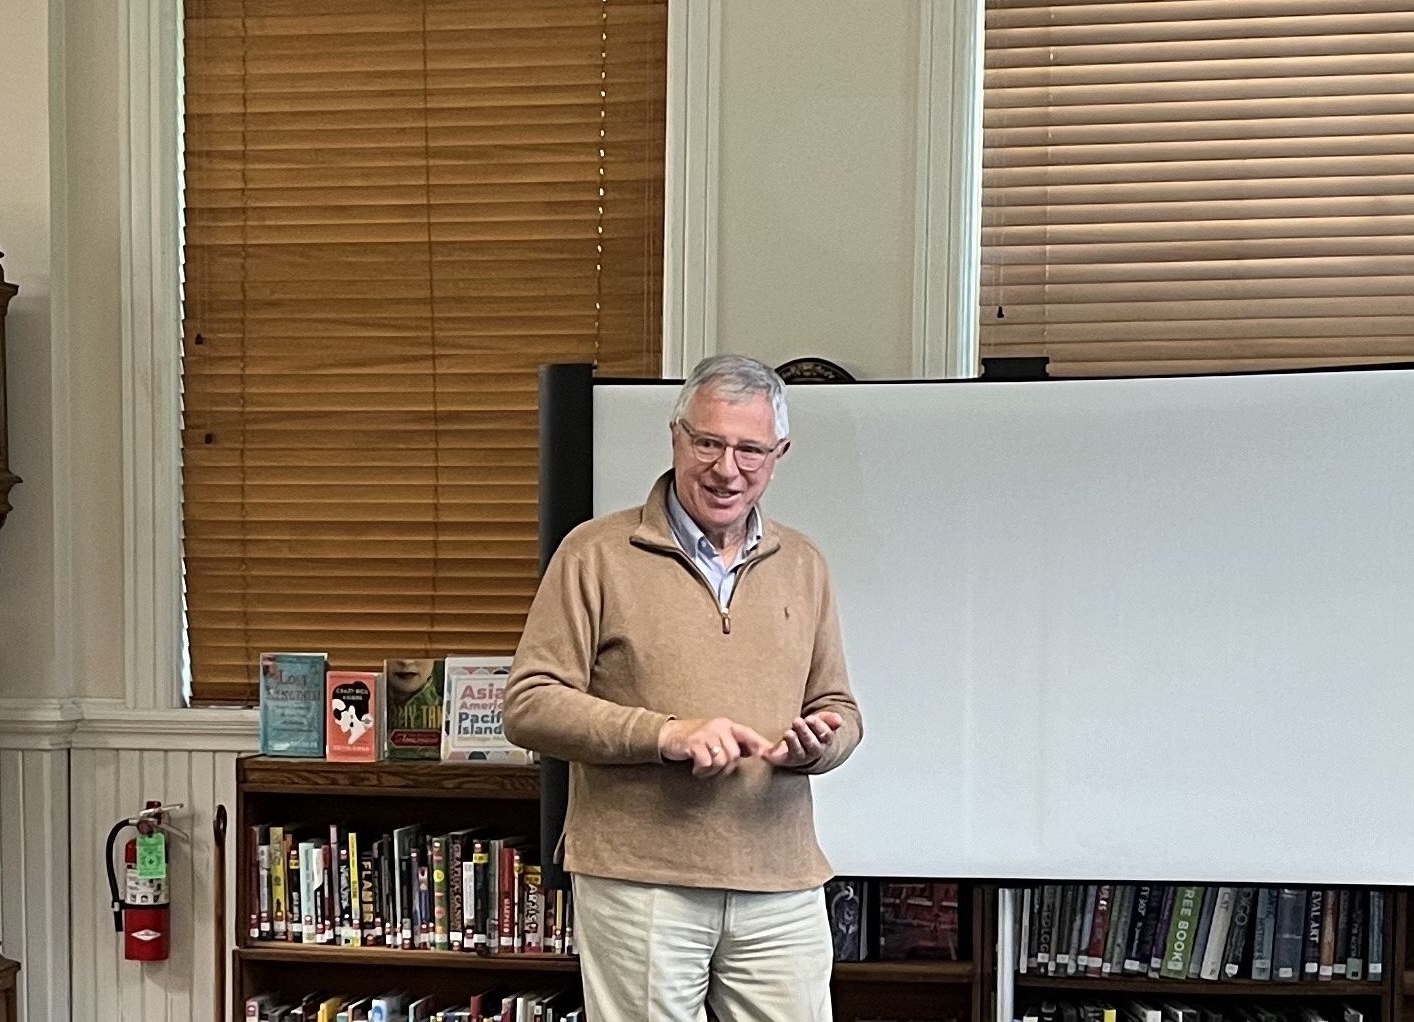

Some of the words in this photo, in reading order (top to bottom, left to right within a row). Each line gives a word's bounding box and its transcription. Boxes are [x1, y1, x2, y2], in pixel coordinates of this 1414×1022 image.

[461, 682, 505, 700] Asia
[460, 700, 505, 710] Americ
[458, 709, 503, 724] Pacif
[458, 724, 503, 735] Island
[1311, 891, 1322, 917] EVAL
